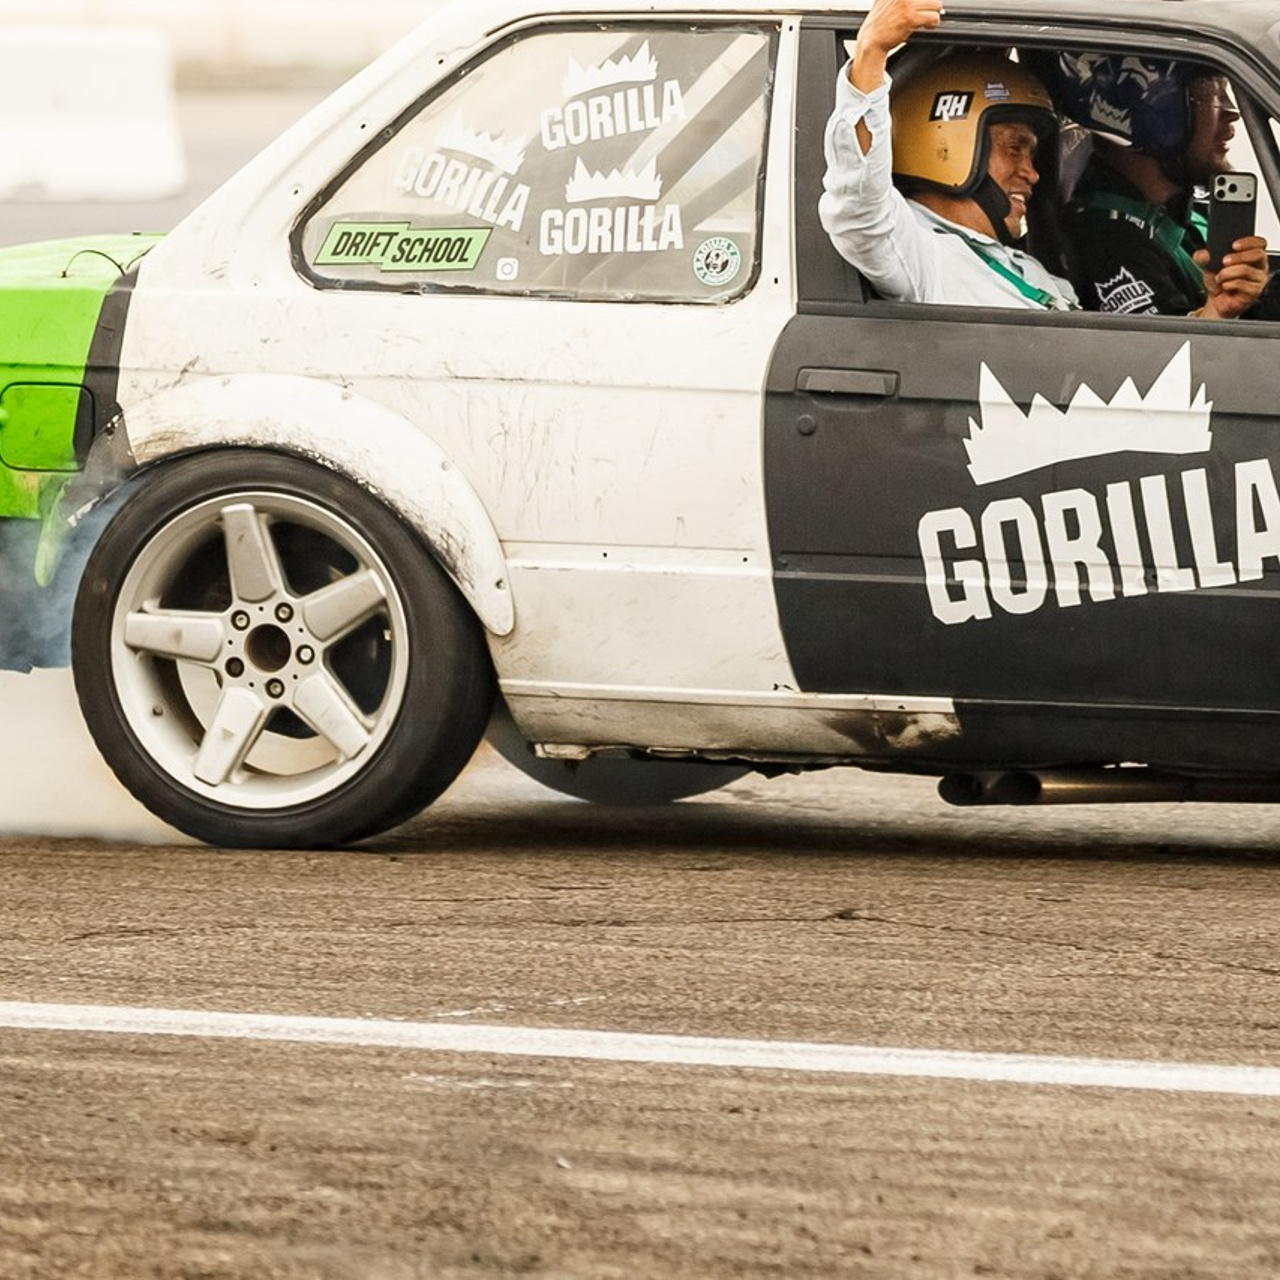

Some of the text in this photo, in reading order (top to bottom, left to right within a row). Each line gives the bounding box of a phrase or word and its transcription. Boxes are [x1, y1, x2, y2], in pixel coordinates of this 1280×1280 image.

[541, 79, 687, 151] GORILLA
[934, 94, 968, 122] RH
[393, 145, 531, 232] GORILLA
[330, 232, 473, 263] DRIFT SCHOOL
[539, 204, 684, 256] GORILLA
